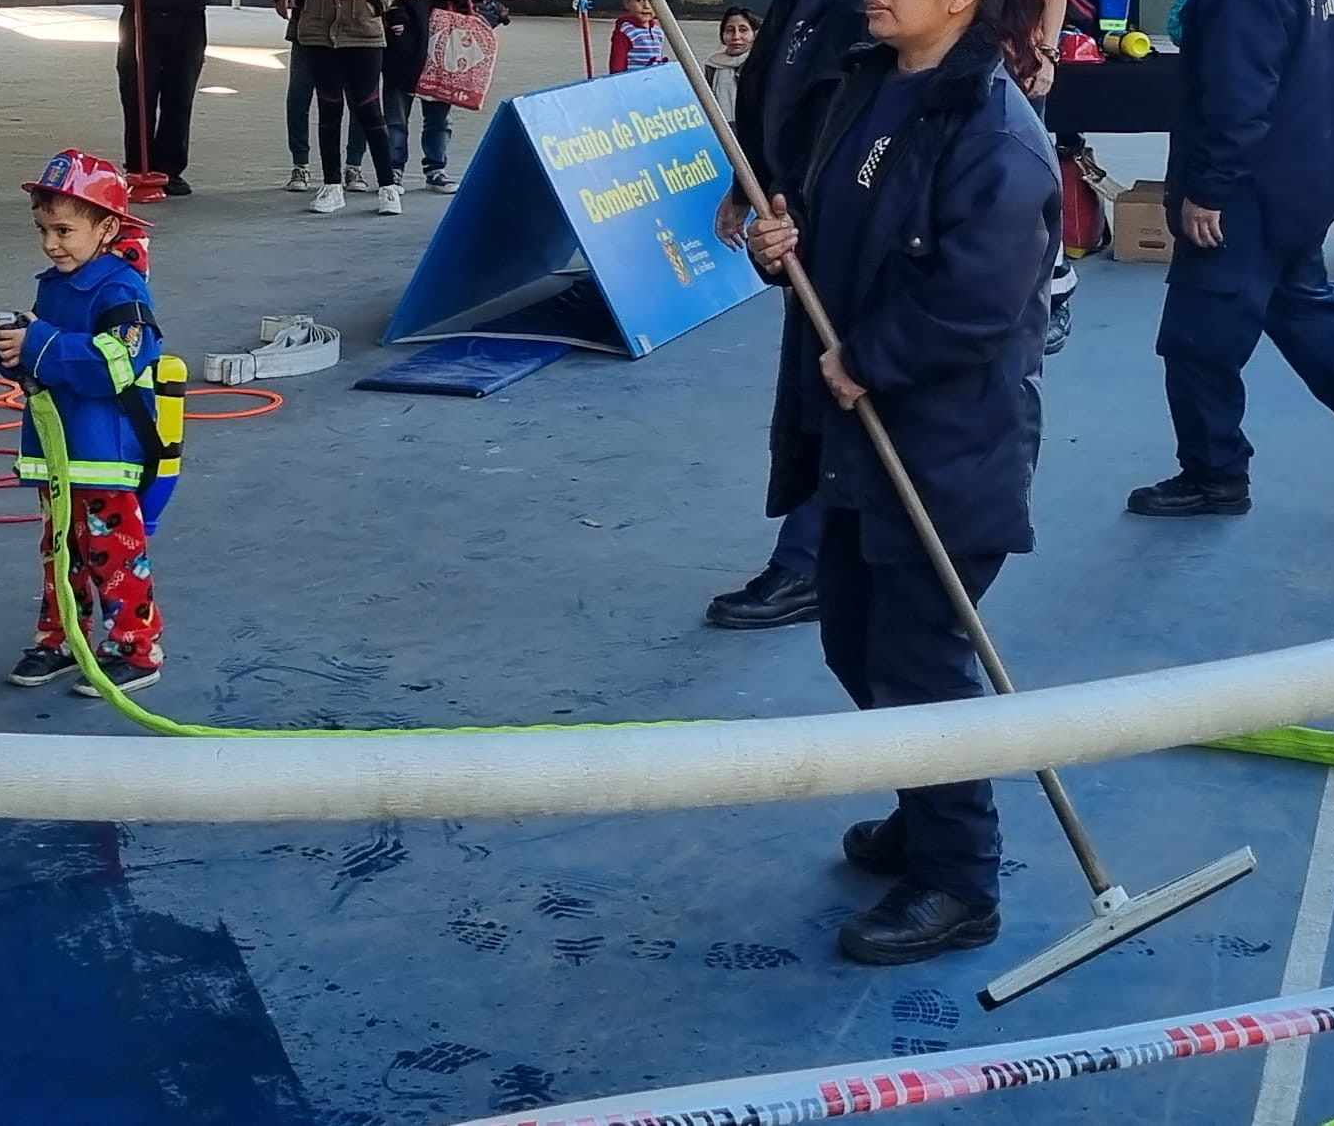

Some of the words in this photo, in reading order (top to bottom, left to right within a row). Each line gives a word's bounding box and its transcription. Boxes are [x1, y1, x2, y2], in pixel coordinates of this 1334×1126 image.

[541, 126, 613, 170] Circuito
[611, 118, 636, 149] de
[628, 104, 705, 144] Destreza
[578, 168, 660, 223] Bomberil
[657, 148, 719, 195] Infantil
